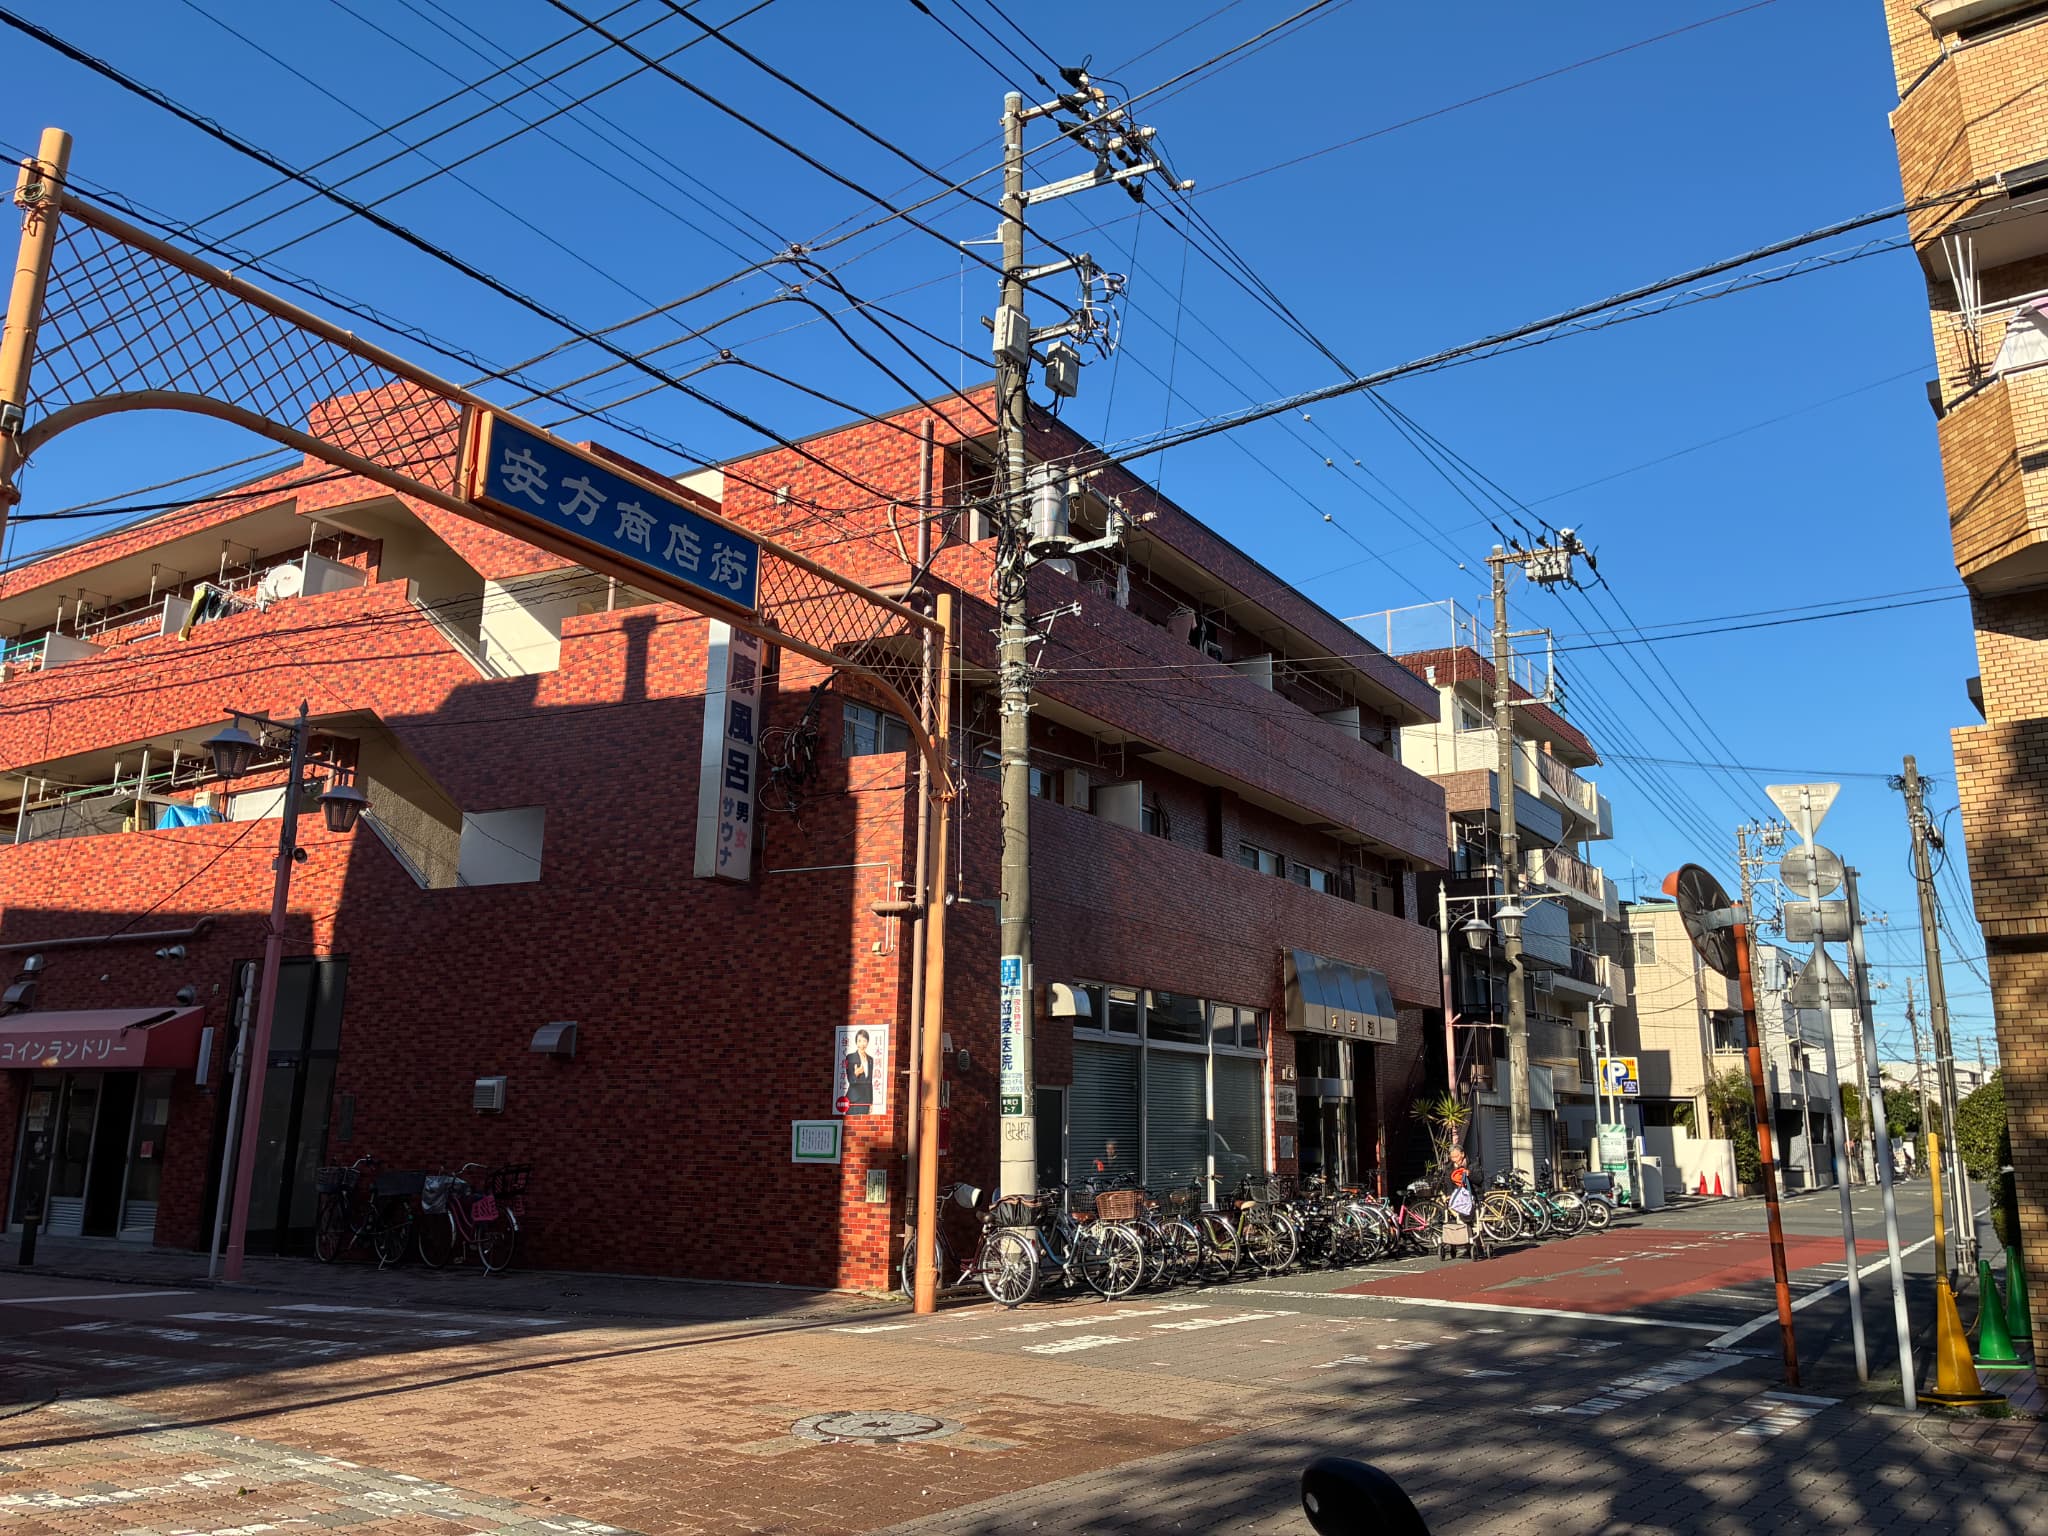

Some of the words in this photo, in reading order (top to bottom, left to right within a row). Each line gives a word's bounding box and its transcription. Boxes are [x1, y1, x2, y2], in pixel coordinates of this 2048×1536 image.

[500, 447, 748, 591] 安方商店街
[719, 796, 736, 867] サウナ
[1, 1038, 128, 1062] コインランドリー
